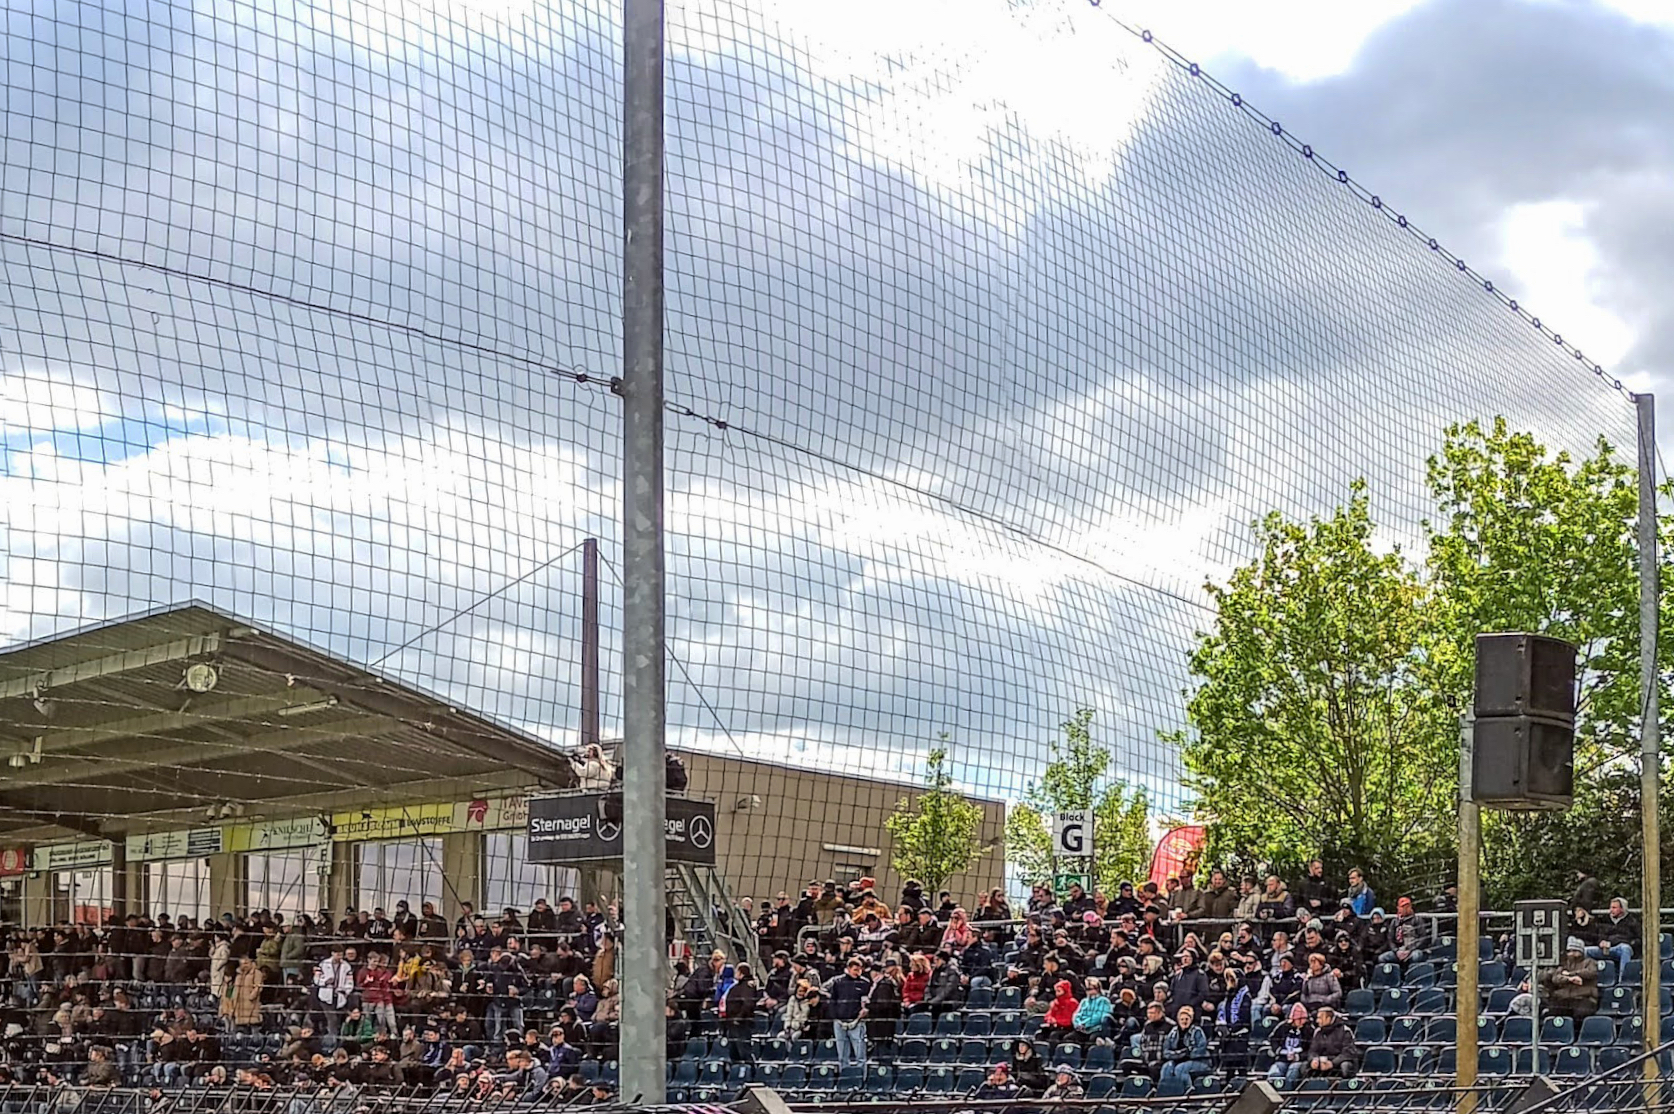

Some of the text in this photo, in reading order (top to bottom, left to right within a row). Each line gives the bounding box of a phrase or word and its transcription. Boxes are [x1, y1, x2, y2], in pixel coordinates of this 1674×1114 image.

[531, 814, 591, 834] Sternagel
[1060, 813, 1084, 822] Block
[1061, 825, 1083, 852] G
